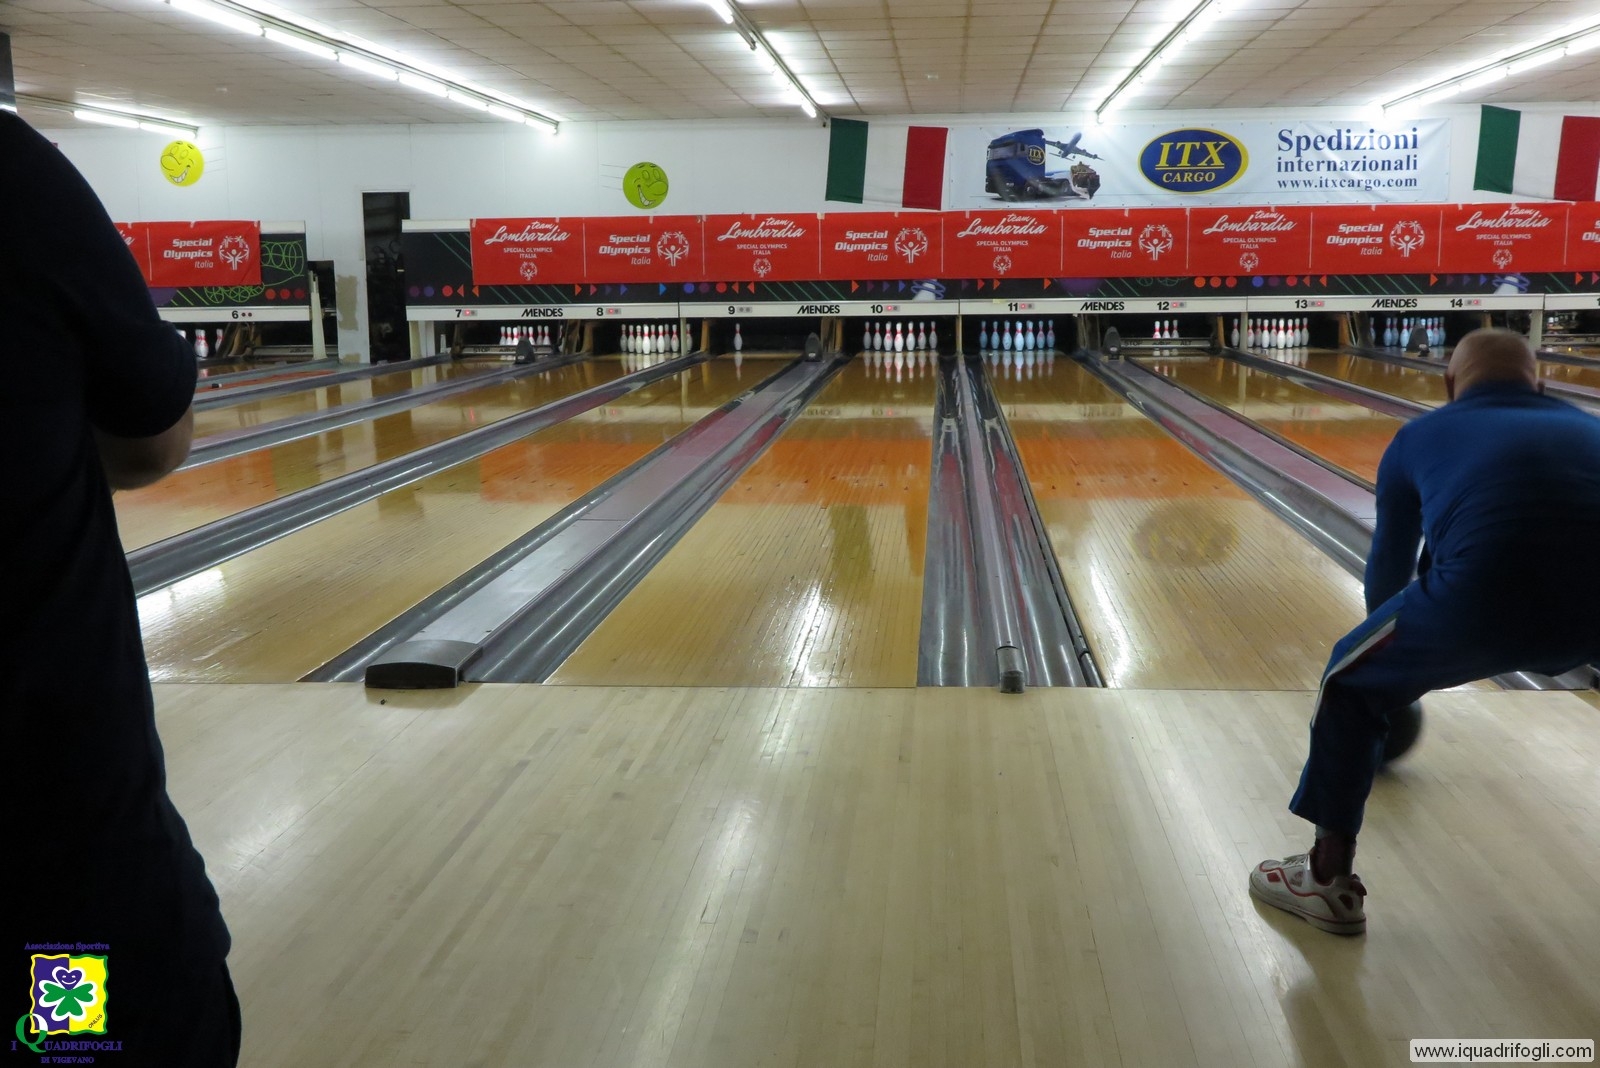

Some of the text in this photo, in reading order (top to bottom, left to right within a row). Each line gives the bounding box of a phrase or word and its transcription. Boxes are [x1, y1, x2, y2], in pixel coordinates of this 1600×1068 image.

[1277, 127, 1419, 155] Spedizioni
[1156, 141, 1229, 167] ITX
[1277, 154, 1418, 173] internazionali
[1162, 171, 1216, 183] CARGO
[1276, 174, 1418, 191] www.itxcargo.com
[1007, 214, 1031, 223] team
[1254, 210, 1279, 219] team
[531, 221, 554, 230] team
[765, 218, 788, 226] team
[1203, 215, 1296, 234] Lombardia
[1456, 211, 1552, 231] Lombardia
[717, 222, 806, 241] Lombardia
[957, 219, 1048, 237] Lombardia
[1089, 227, 1132, 238] Special
[1338, 224, 1384, 234] Special
[484, 226, 571, 245] Lombardia
[609, 234, 651, 244] Special
[845, 230, 888, 241] Special
[1327, 235, 1383, 246] Olympics
[172, 238, 213, 249] Special
[835, 241, 888, 252] Olympics
[1077, 239, 1132, 249] Olympics
[163, 249, 213, 260] Olympics
[599, 245, 651, 256] Olympics
[1110, 250, 1132, 259] Italia
[1360, 247, 1382, 256] Italia
[631, 257, 651, 265] Italia
[867, 253, 888, 262] Italia
[194, 261, 214, 269] Italia
[1008, 302, 1018, 311] 11
[1080, 301, 1125, 311] MENDES
[1157, 301, 1169, 311] 12
[1295, 300, 1308, 309] 13
[1372, 298, 1417, 308] MENDES
[1450, 299, 1463, 308] 14
[456, 309, 462, 318] 7
[521, 308, 563, 318] MENDES
[596, 307, 603, 317] 8
[728, 305, 735, 314] 9
[797, 304, 840, 314] MENDES
[870, 304, 883, 314] 10
[231, 310, 239, 319] 6
